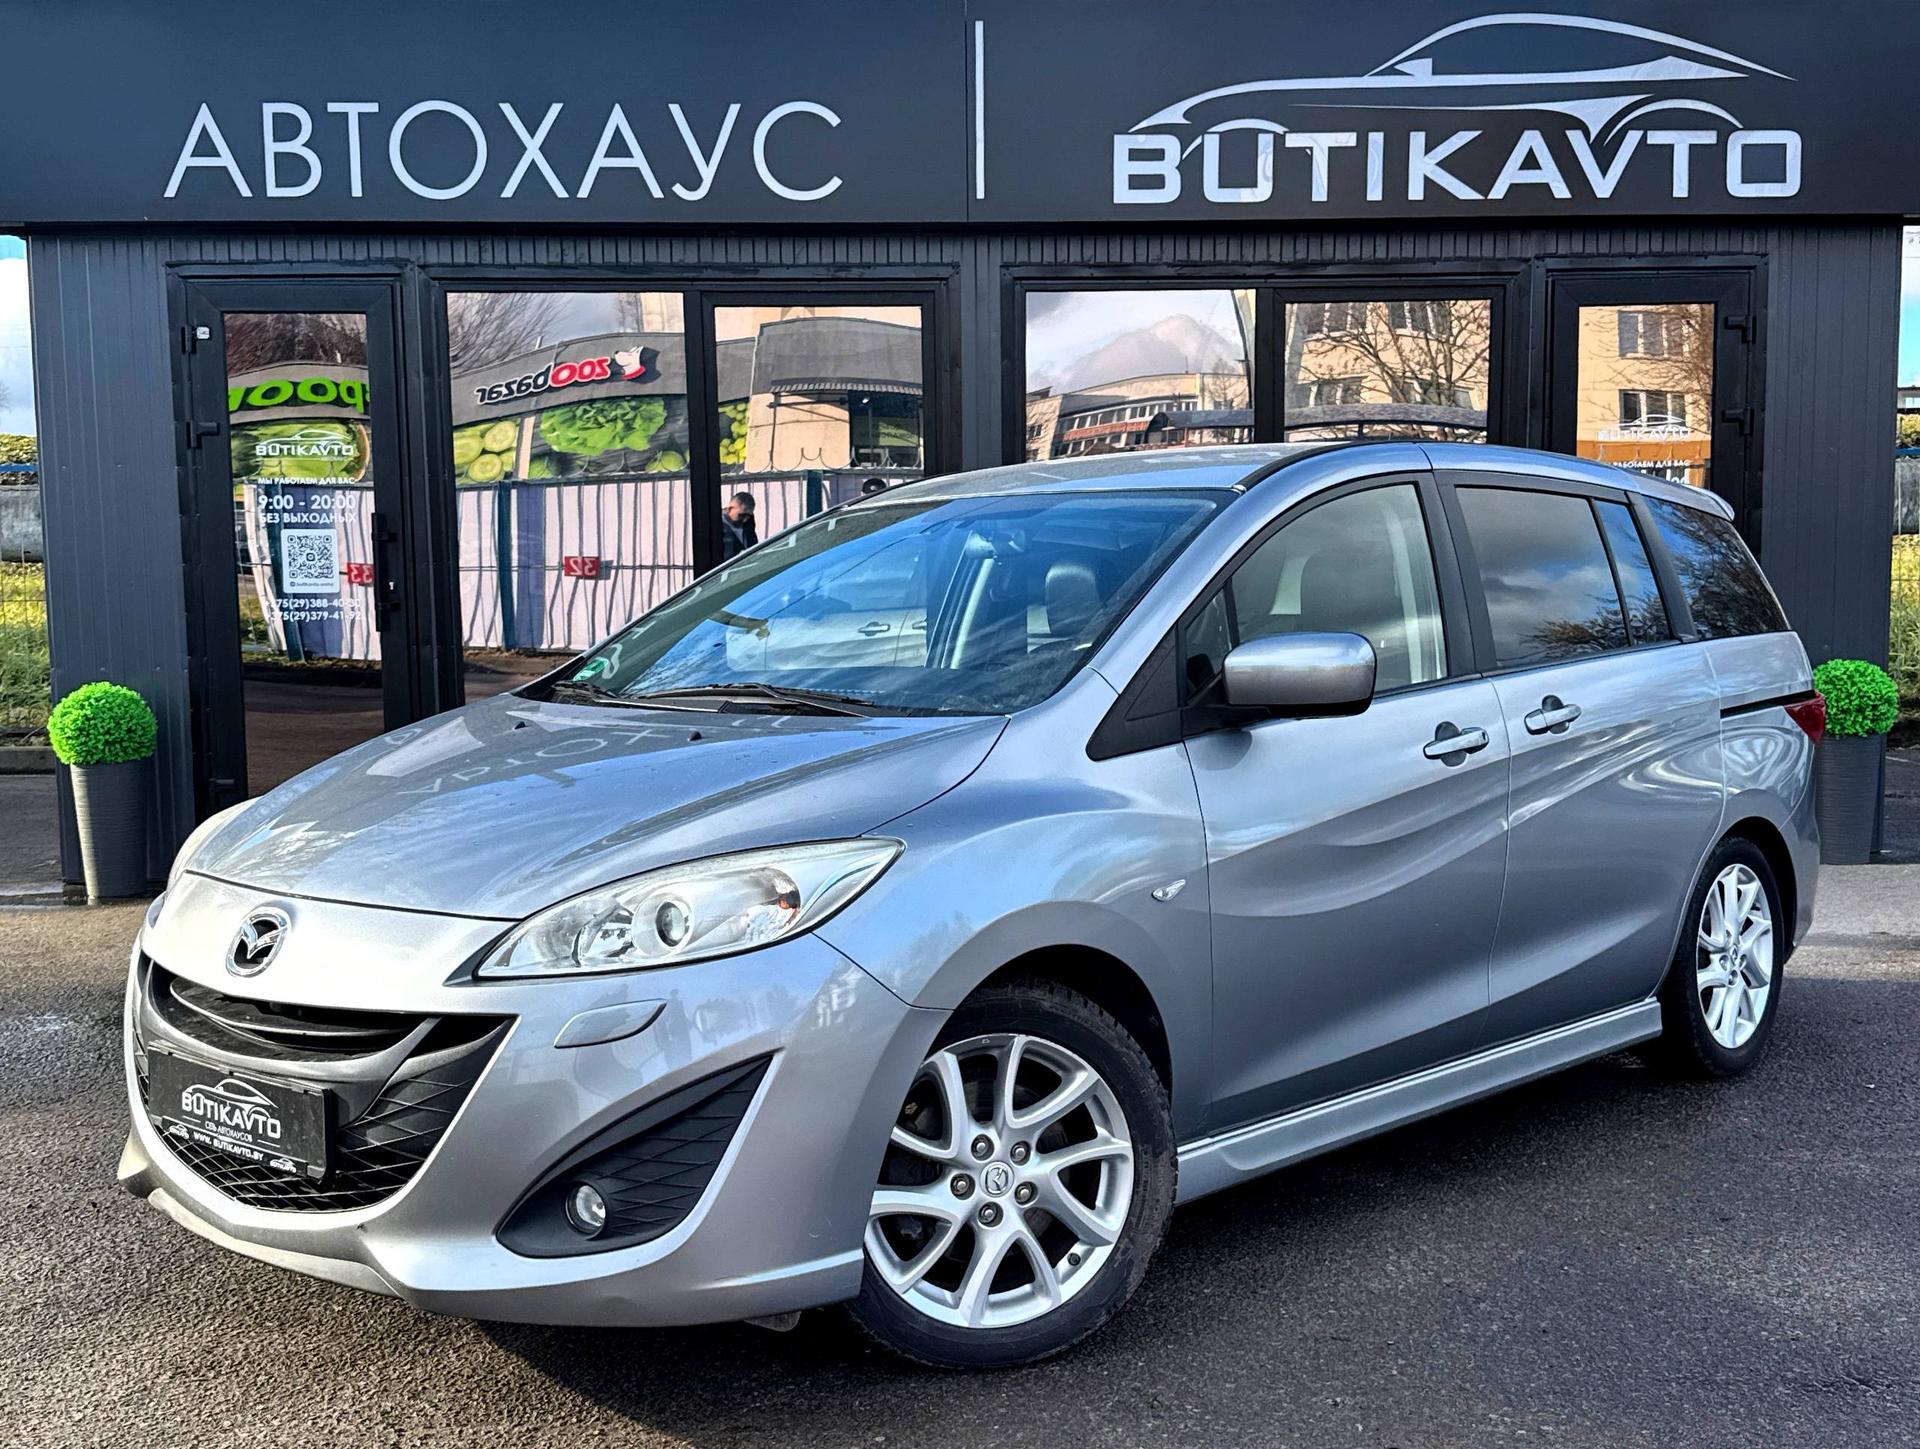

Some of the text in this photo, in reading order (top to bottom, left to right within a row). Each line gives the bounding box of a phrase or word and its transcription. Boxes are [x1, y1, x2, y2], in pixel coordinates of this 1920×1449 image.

[163, 100, 843, 201] АВТОХАУС
[1113, 129, 1802, 204] BUTIKAVTO
[255, 443, 354, 456] BUTIKAVTO
[257, 476, 356, 485] МЫ РАБОТАЕМ ДЛЯ ВАС
[258, 495, 294, 510] 9:00
[310, 495, 356, 510] 20:00
[260, 512, 357, 524] БЕЗ ВЫХОДНЫХ
[182, 1091, 281, 1139] BUTIKAVTO
